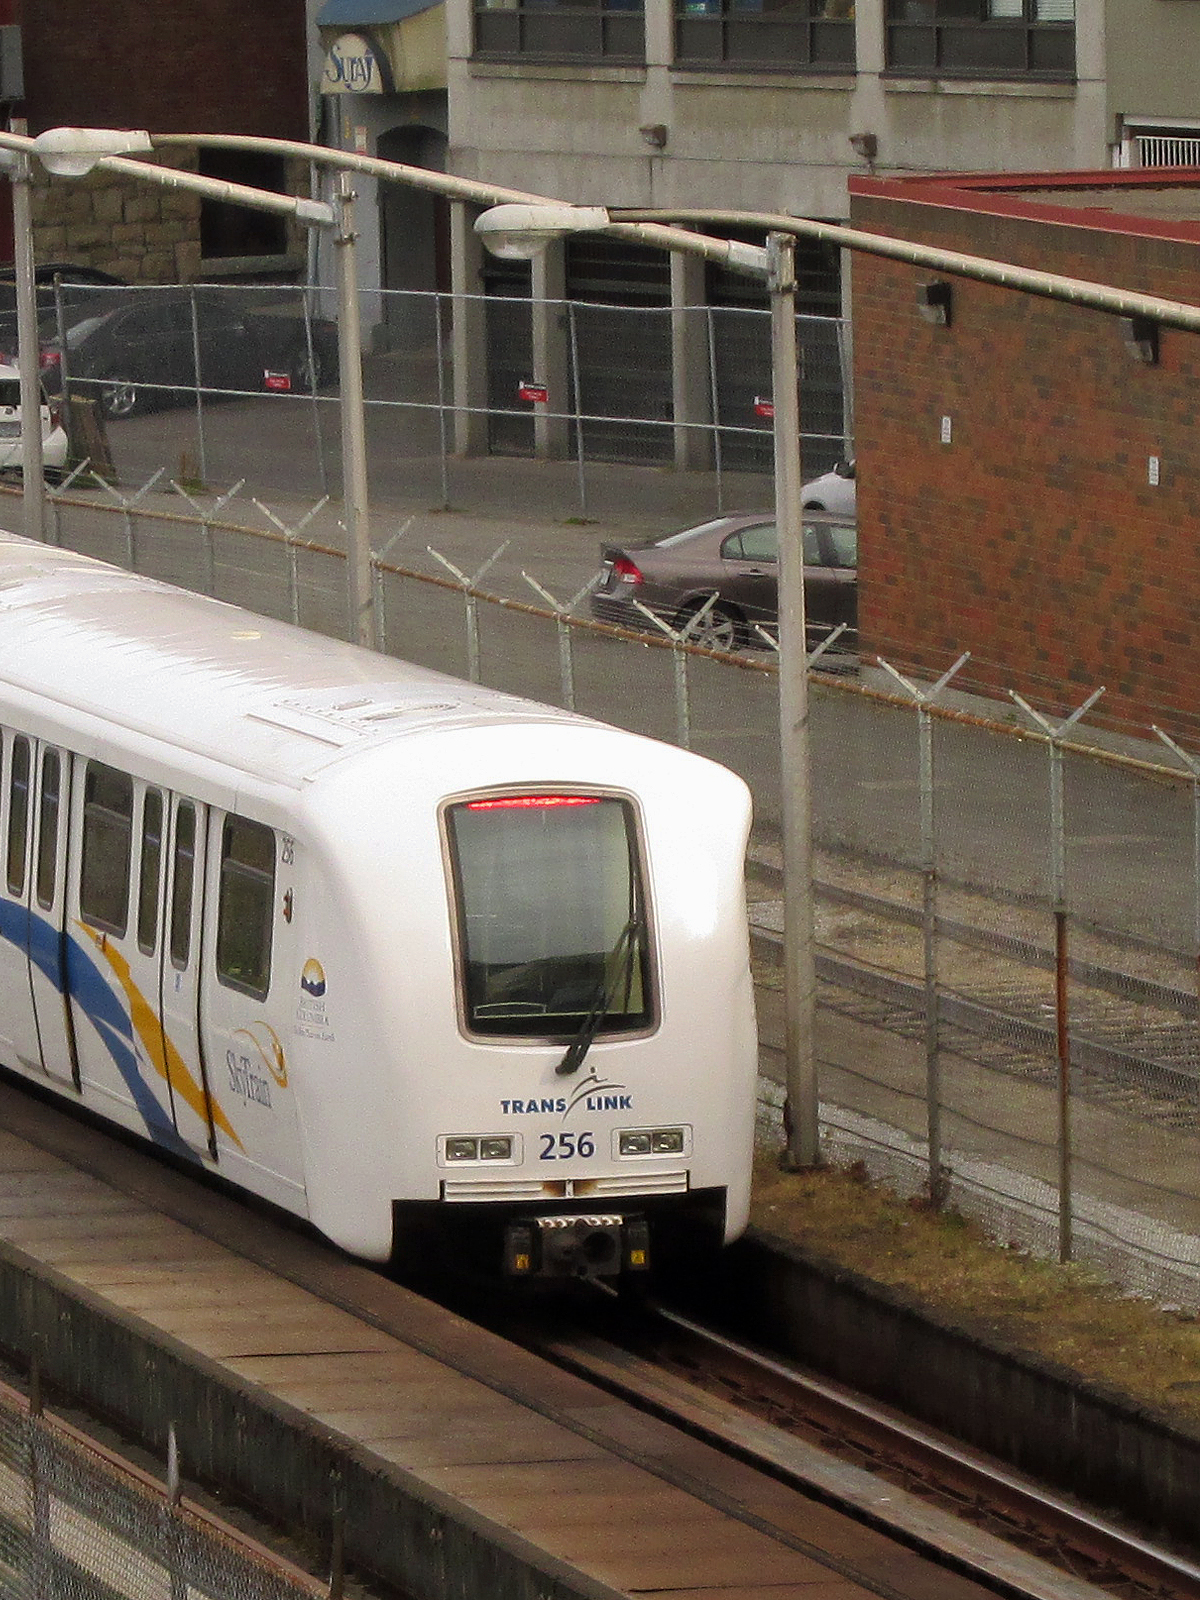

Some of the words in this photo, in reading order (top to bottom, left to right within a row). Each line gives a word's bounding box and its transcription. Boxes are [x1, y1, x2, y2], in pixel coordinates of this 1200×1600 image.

[500, 1098, 567, 1114] TRANS
[586, 1095, 633, 1111] LINK
[540, 1132, 595, 1160] 256
